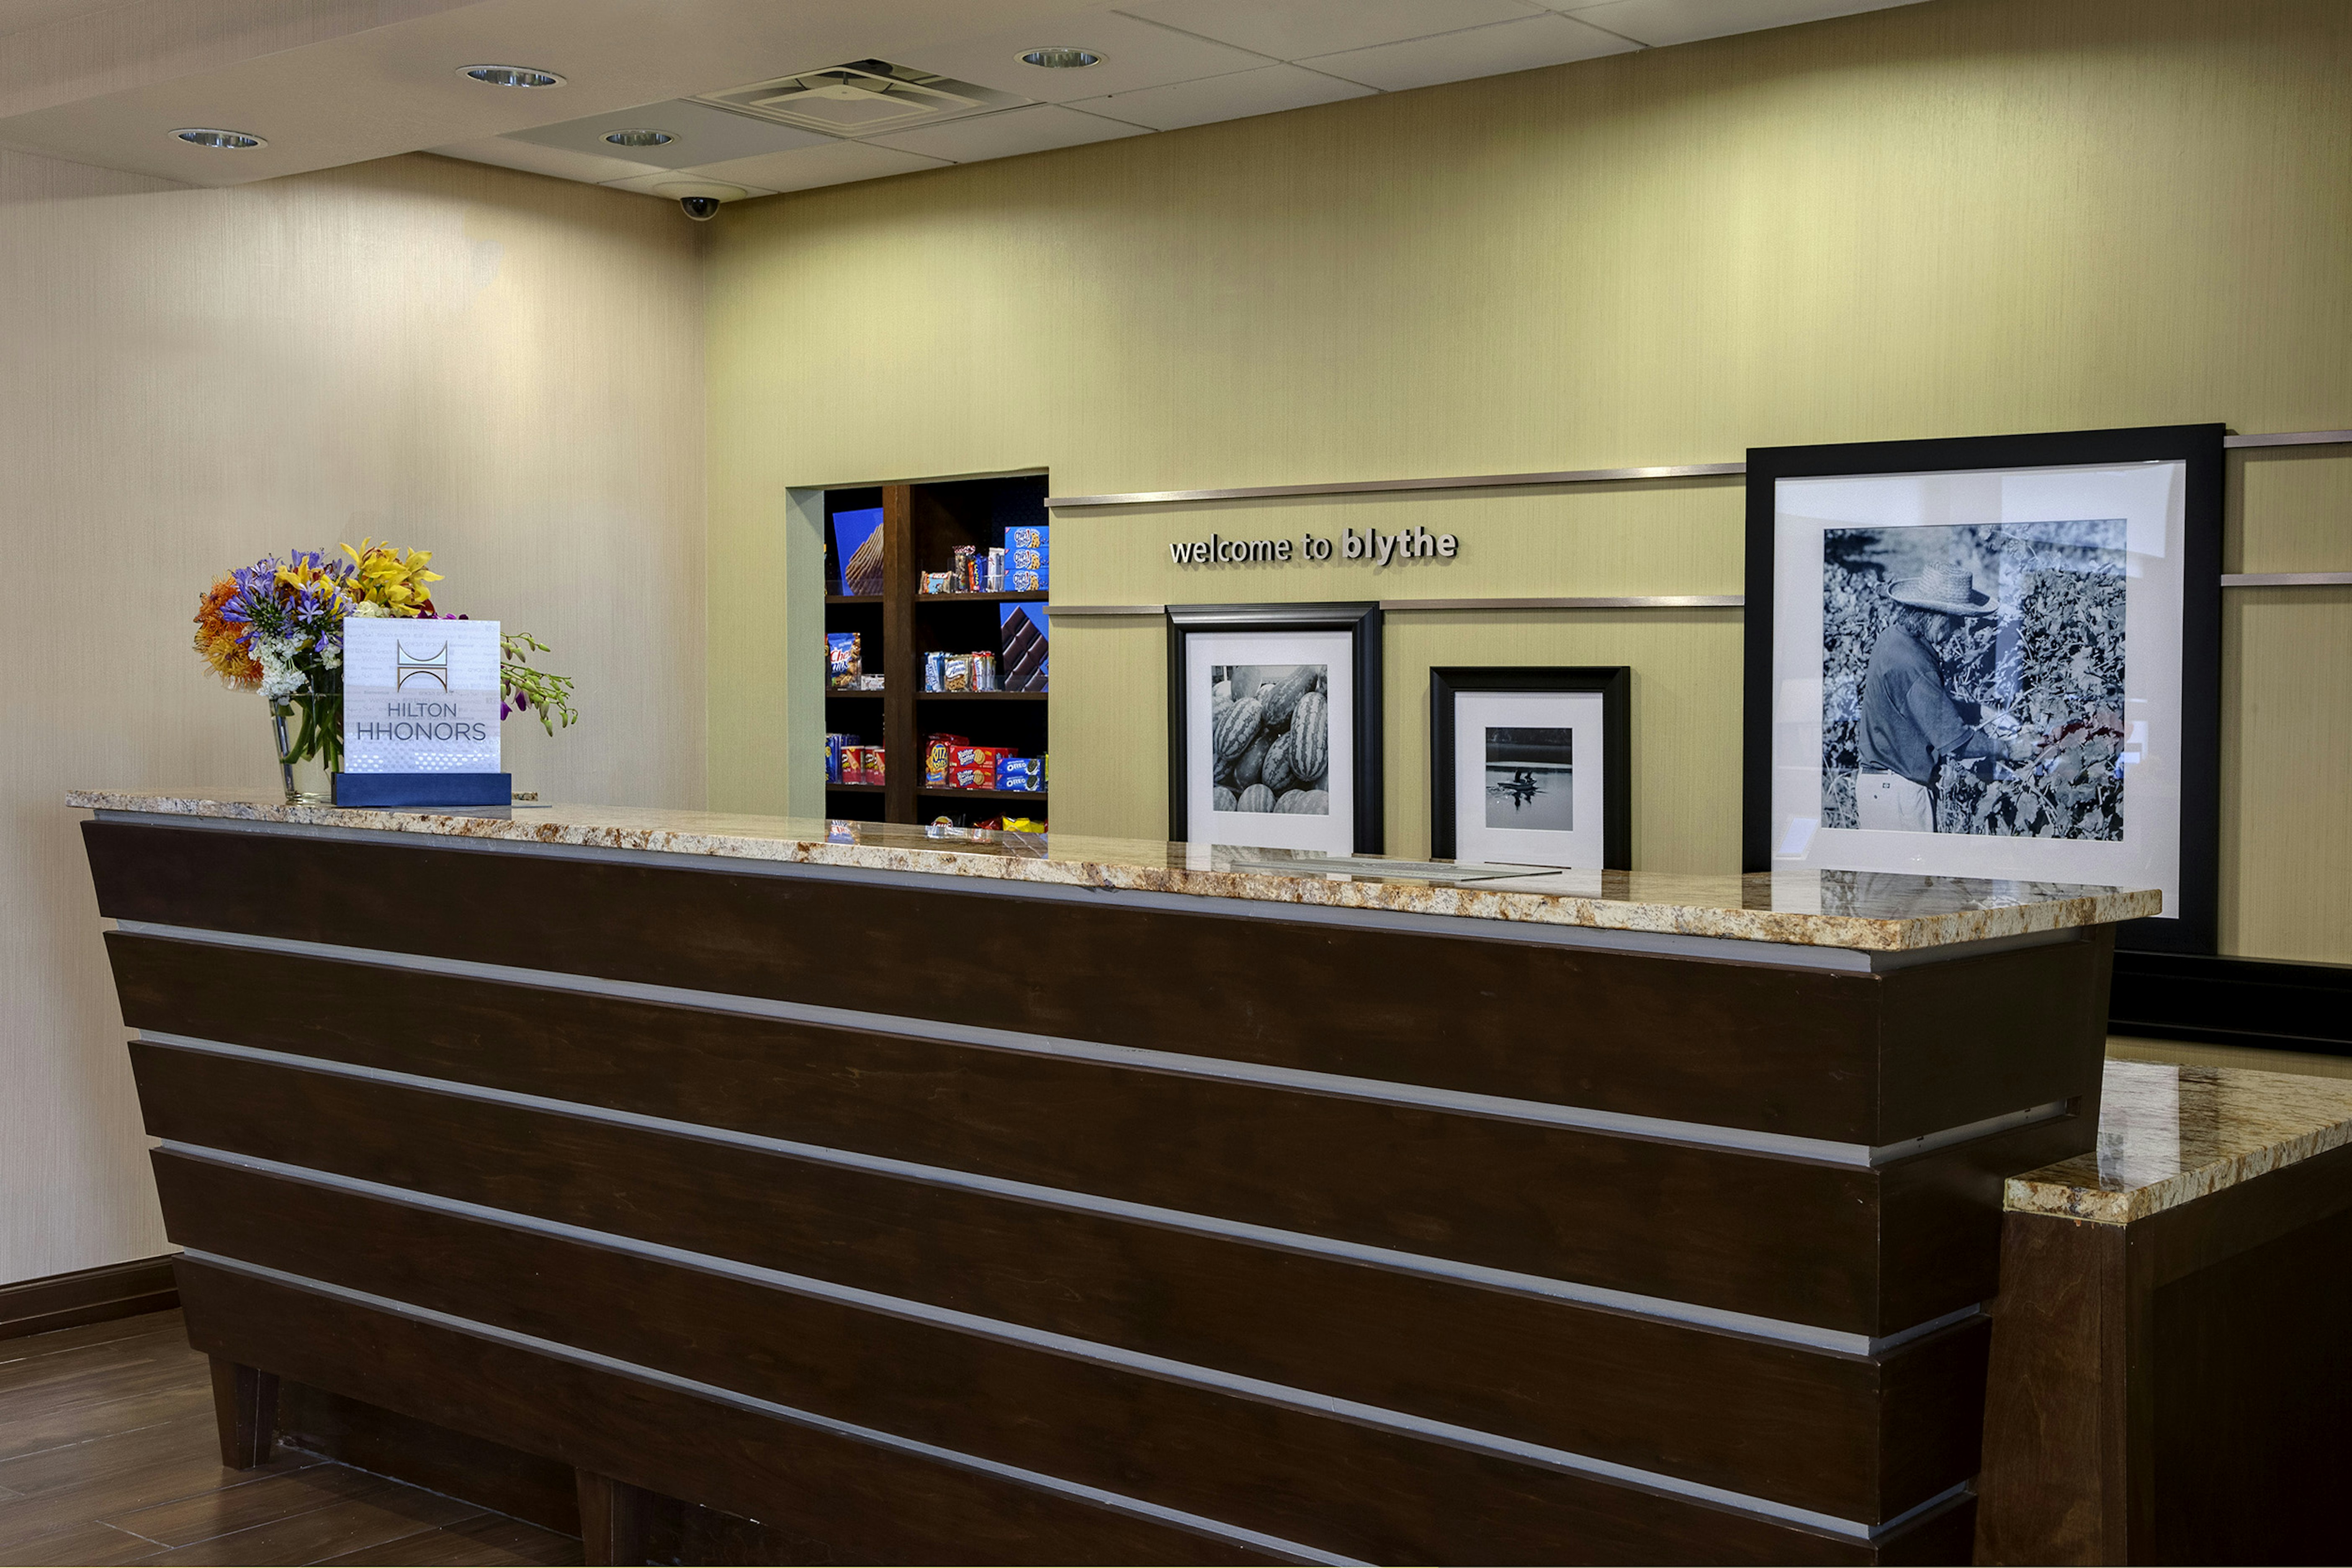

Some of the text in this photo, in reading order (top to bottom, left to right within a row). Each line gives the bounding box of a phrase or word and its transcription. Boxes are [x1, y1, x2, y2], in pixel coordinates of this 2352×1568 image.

[1169, 526, 1458, 566] welcome to blythe
[388, 703, 456, 717] HILTON
[358, 722, 486, 740] HHONORS
[932, 747, 947, 763] RITZ
[1007, 763, 1026, 771] OREO
[1006, 779, 1026, 787] OREO
